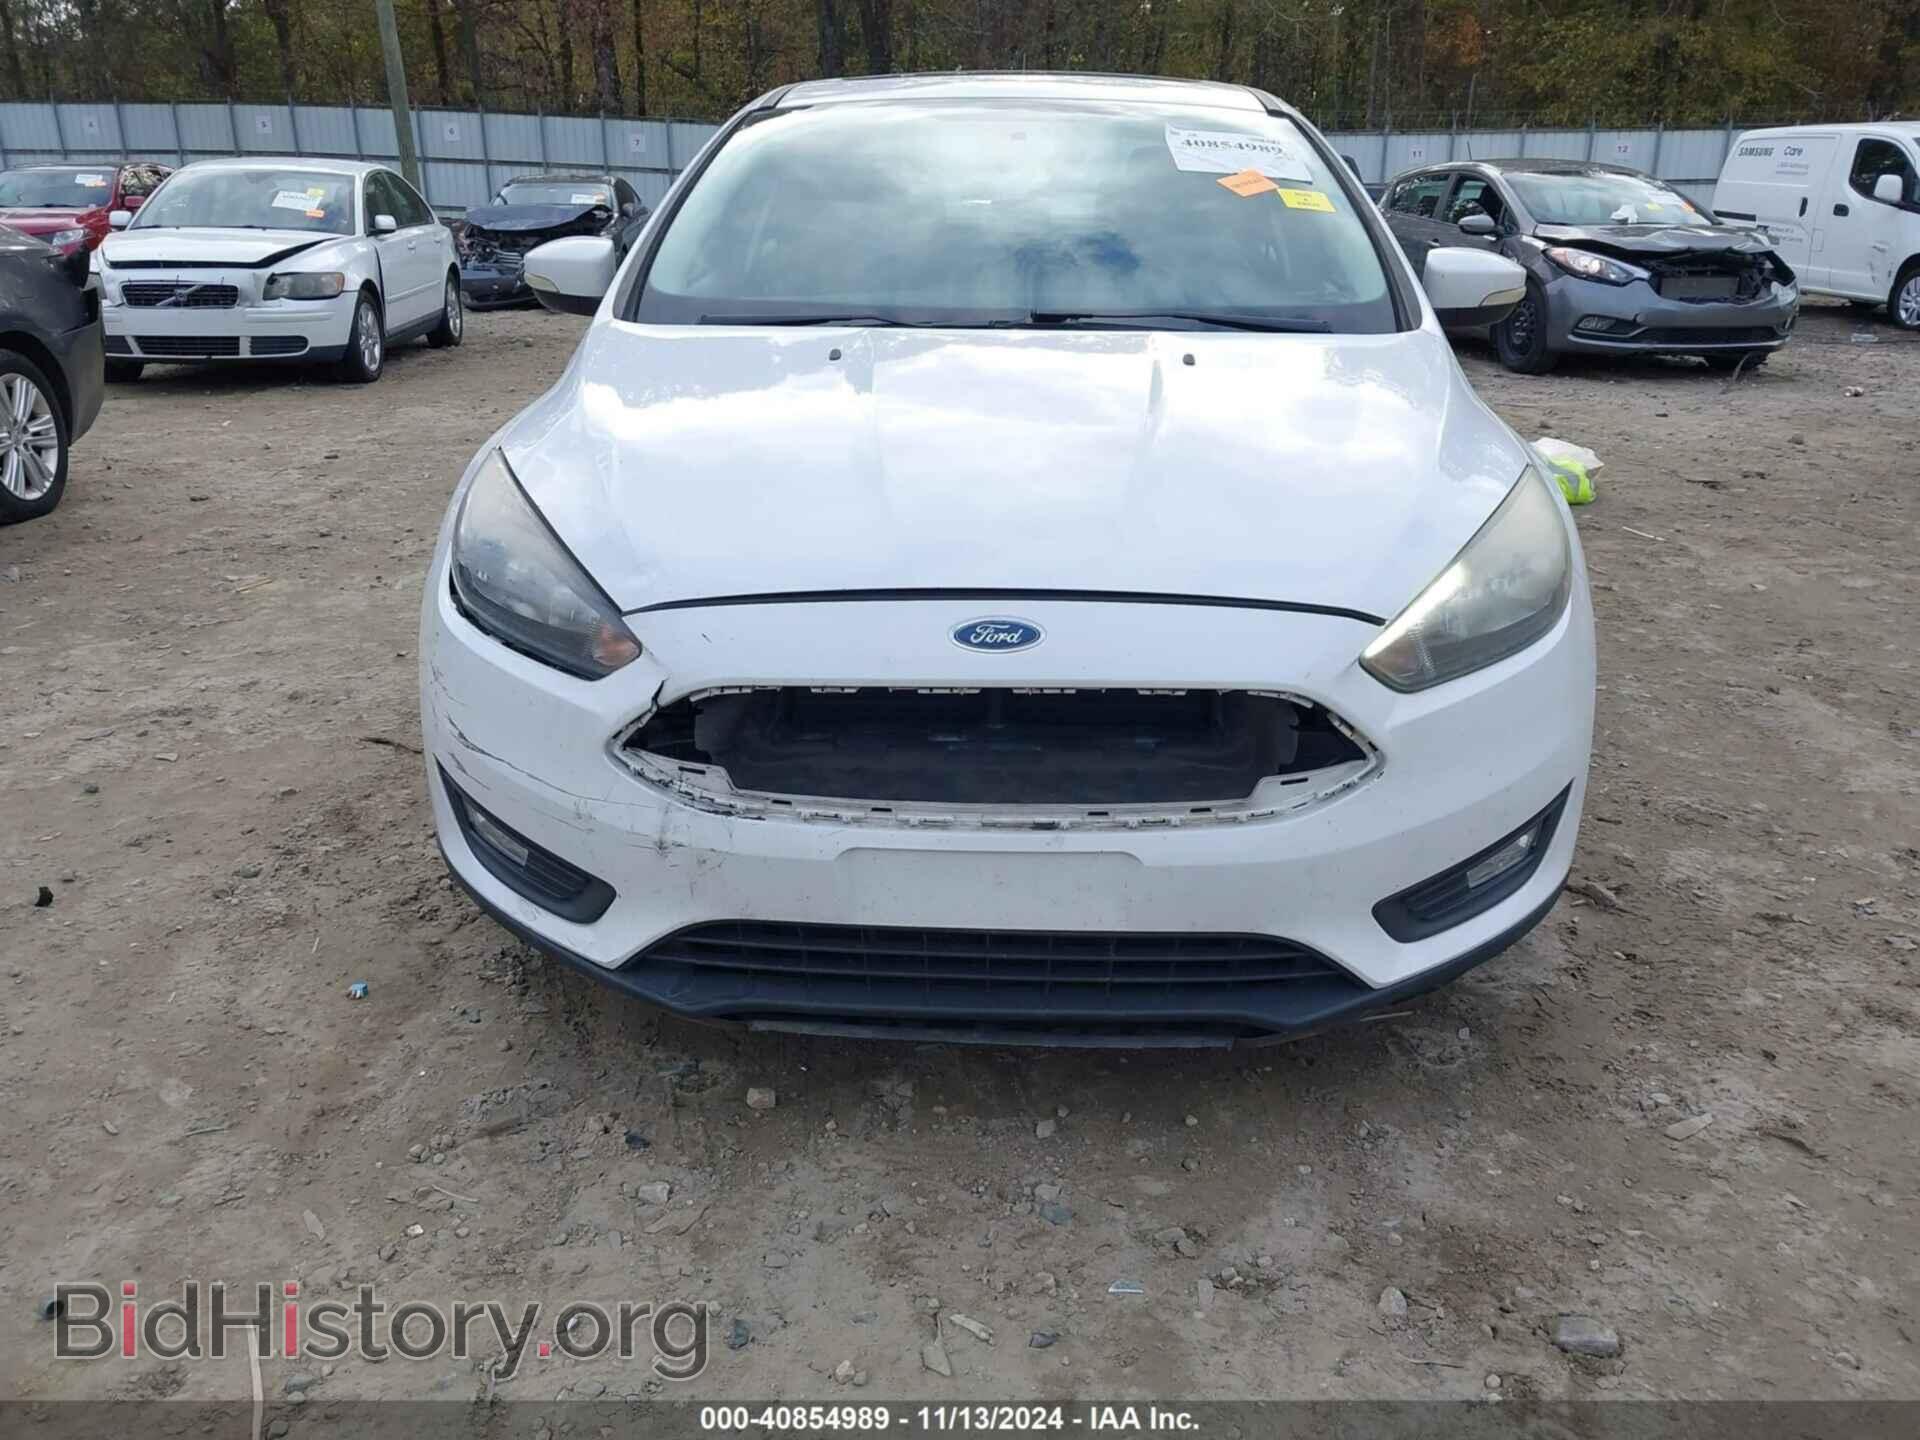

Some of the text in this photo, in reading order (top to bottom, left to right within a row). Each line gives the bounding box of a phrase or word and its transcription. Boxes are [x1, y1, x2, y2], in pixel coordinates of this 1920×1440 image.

[1181, 138, 1283, 155] 40854989
[1617, 145, 1628, 153] 12
[1738, 146, 1804, 157] SAMSUNG Care
[1413, 150, 1422, 158] 11
[970, 623, 1022, 644] Ford
